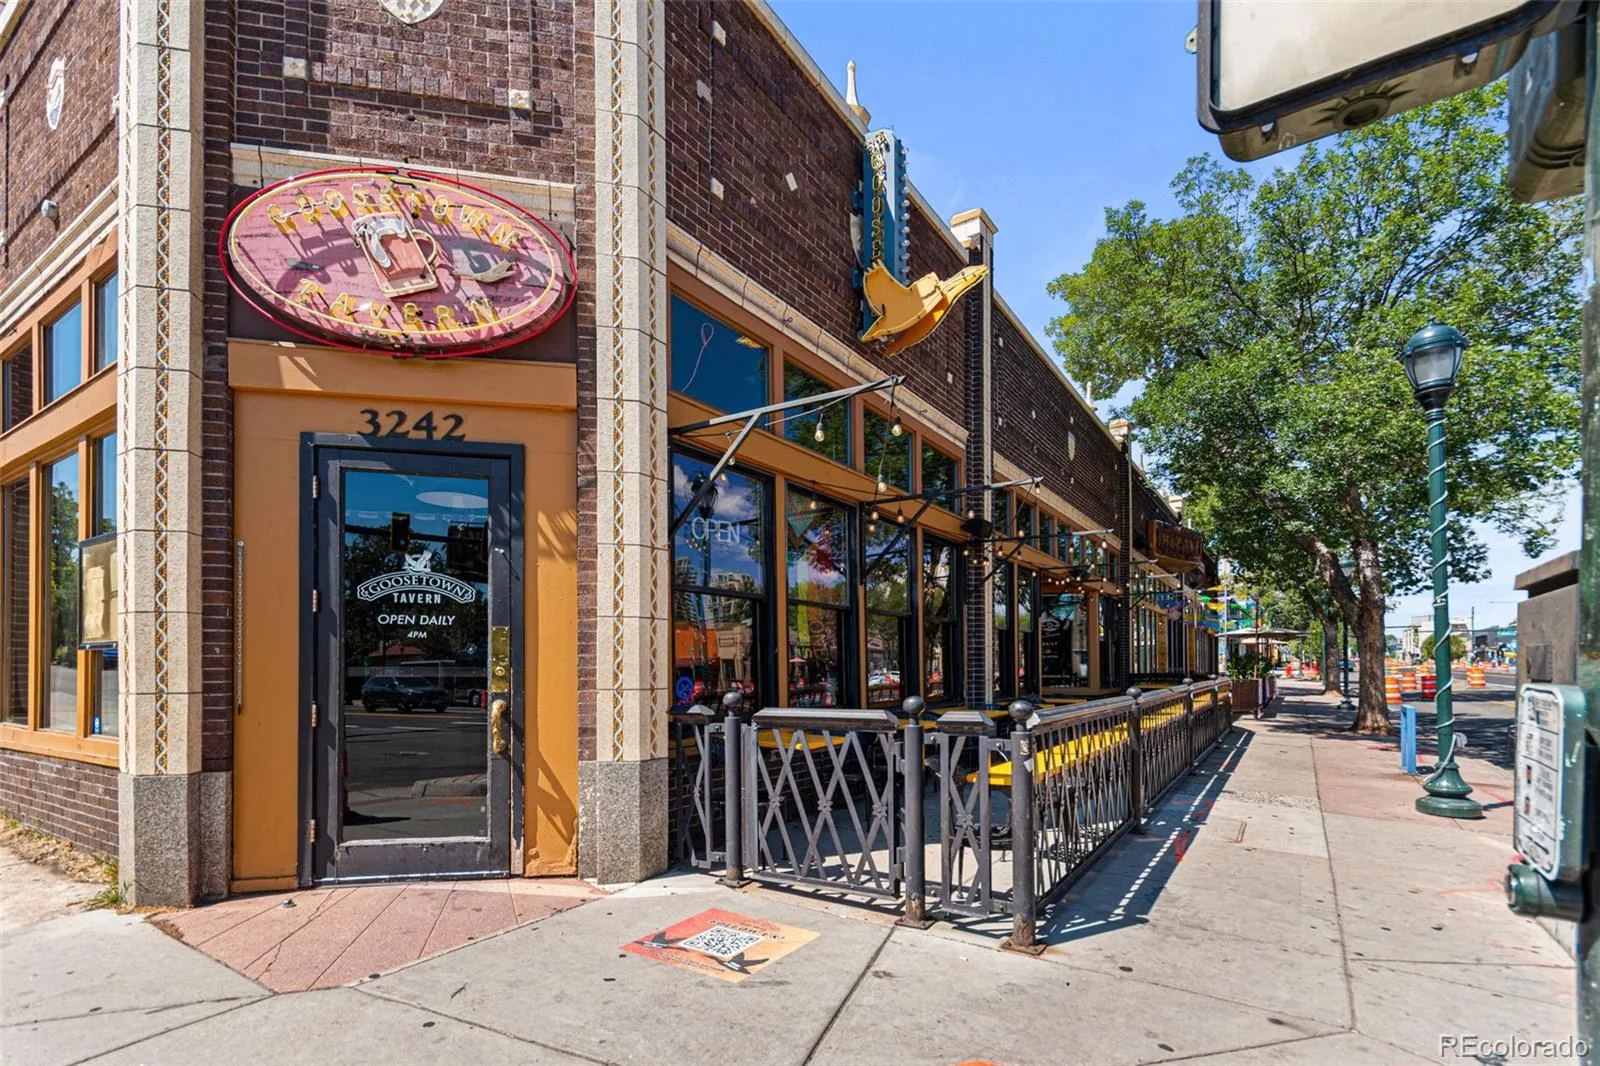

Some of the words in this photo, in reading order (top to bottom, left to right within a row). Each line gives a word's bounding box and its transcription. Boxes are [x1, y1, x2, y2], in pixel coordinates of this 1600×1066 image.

[266, 182, 524, 253] GOOSETOWN
[299, 278, 504, 333] TAVERN
[357, 409, 466, 442] 3242
[691, 516, 740, 544] OPEN
[368, 575, 466, 597] GOOSETOWN
[392, 592, 441, 604] TAVERN
[377, 614, 416, 625] OPEN
[419, 615, 456, 626] DAILY
[407, 631, 427, 639] 4PM
